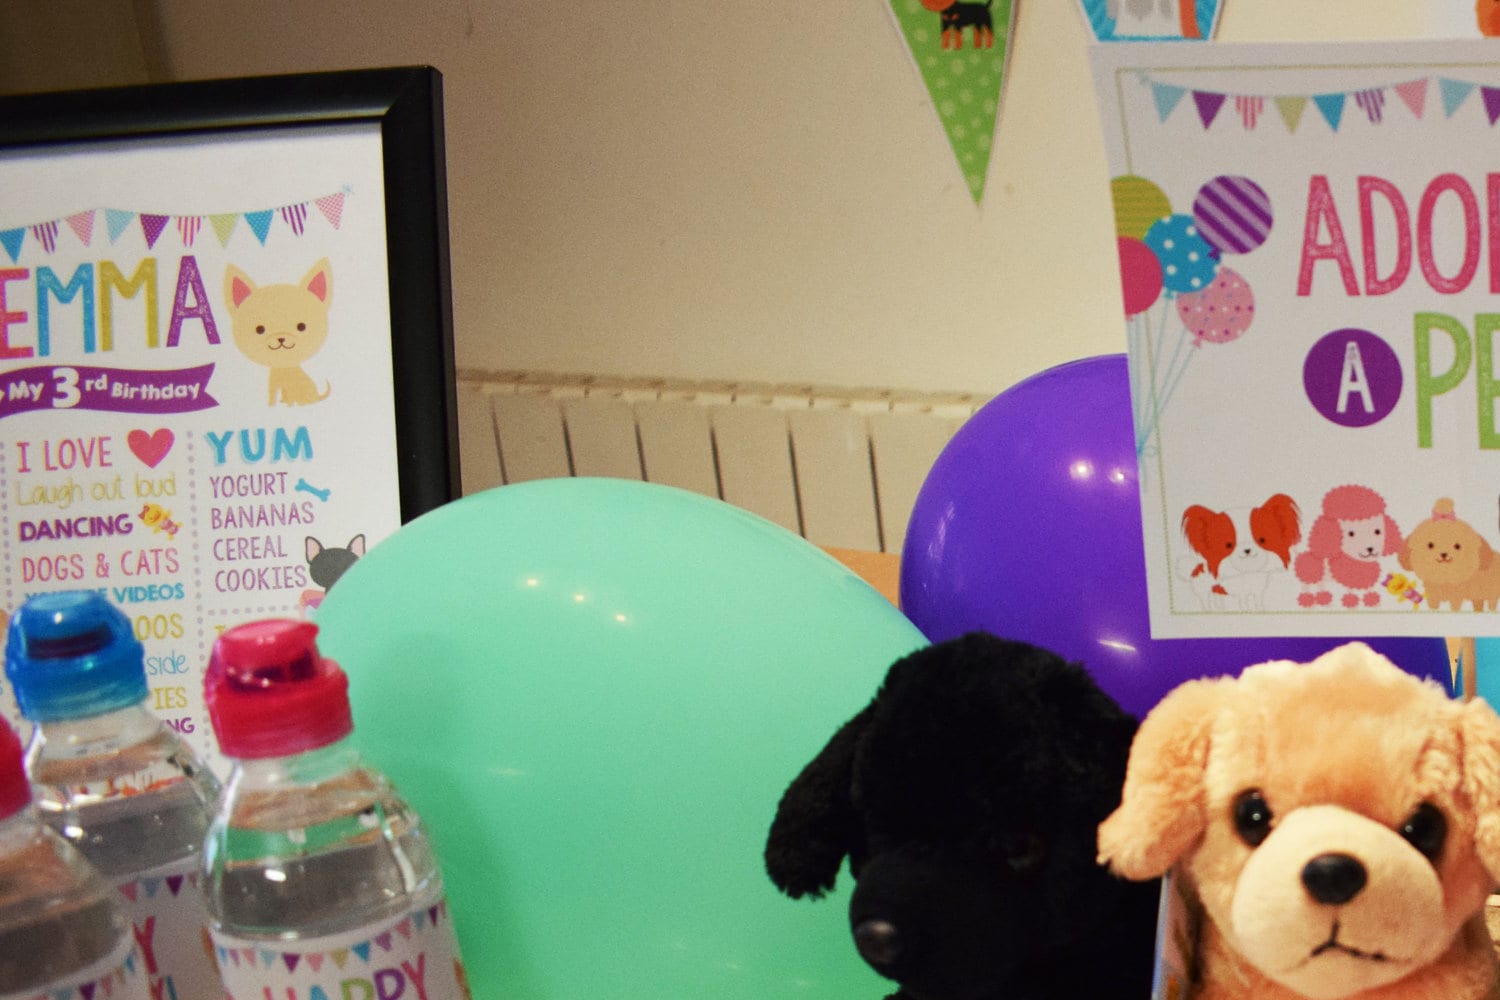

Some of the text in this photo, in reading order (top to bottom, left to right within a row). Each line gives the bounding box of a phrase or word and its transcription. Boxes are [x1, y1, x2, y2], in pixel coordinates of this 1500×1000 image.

[8, 381, 44, 401] My
[111, 382, 201, 401] Birthday
[1335, 341, 1375, 414] A
[16, 436, 113, 473] I LOVE
[205, 426, 313, 464] YUM
[14, 476, 84, 510] Laugh
[90, 474, 126, 500] out
[209, 472, 288, 499] YOGURT
[19, 513, 134, 542] DANCING
[211, 502, 314, 530] BANANAS
[213, 535, 288, 562] CEREAL
[22, 548, 180, 583] DOGS & CATS
[215, 565, 308, 592] COOKIES
[113, 582, 186, 603] VIDEOS
